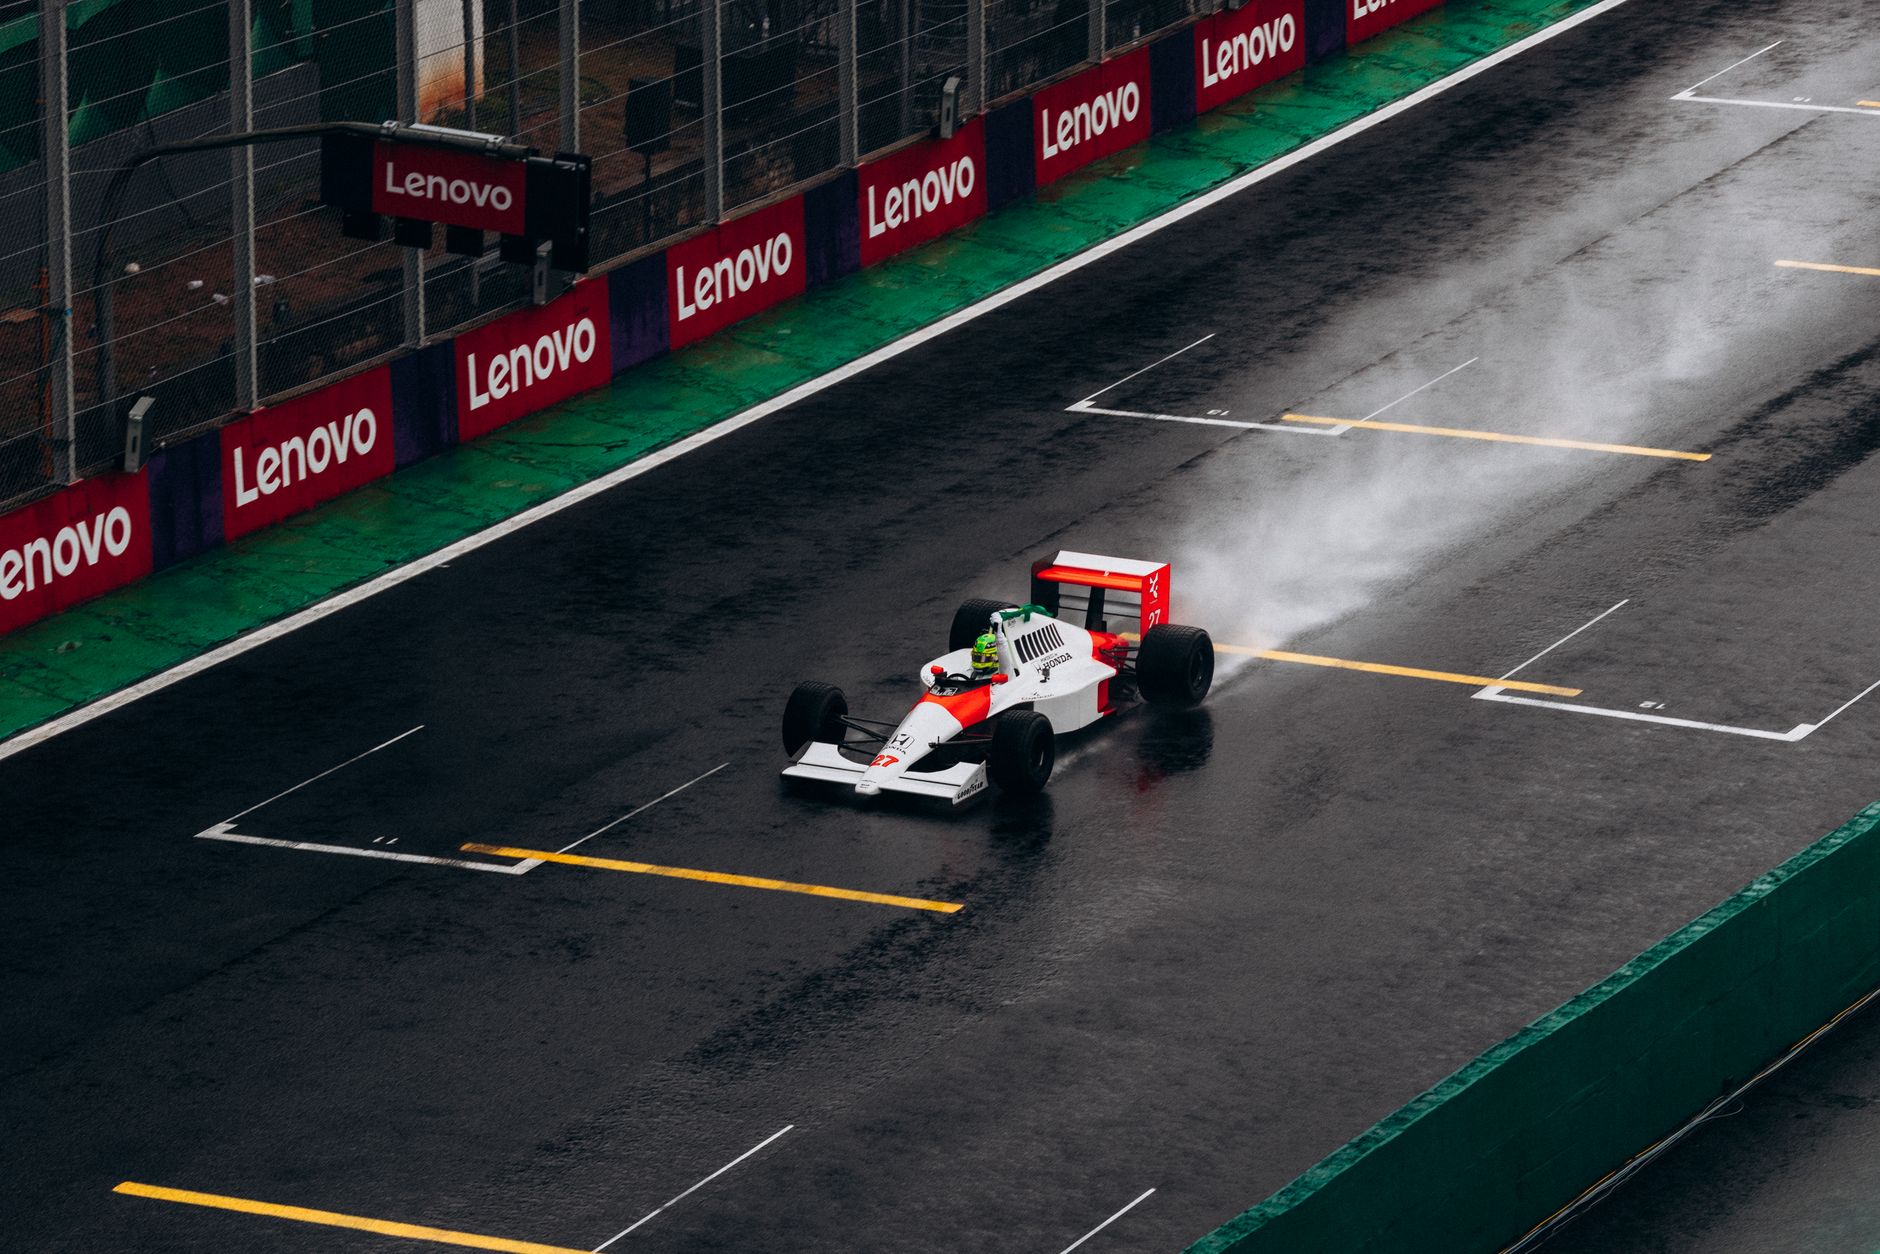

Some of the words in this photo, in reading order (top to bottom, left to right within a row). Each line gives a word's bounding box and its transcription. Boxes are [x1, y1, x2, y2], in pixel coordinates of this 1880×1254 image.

[1202, 14, 1296, 88] Lenovo
[1042, 81, 1140, 160] Lenovo
[387, 162, 512, 210] Lenovo
[868, 155, 975, 239] Lenovo
[676, 232, 792, 321] Lenovo
[467, 317, 596, 411] Lenovo
[233, 407, 377, 508] Lenovo
[1042, 652, 1073, 669] HONDA
[868, 754, 900, 768] 27
